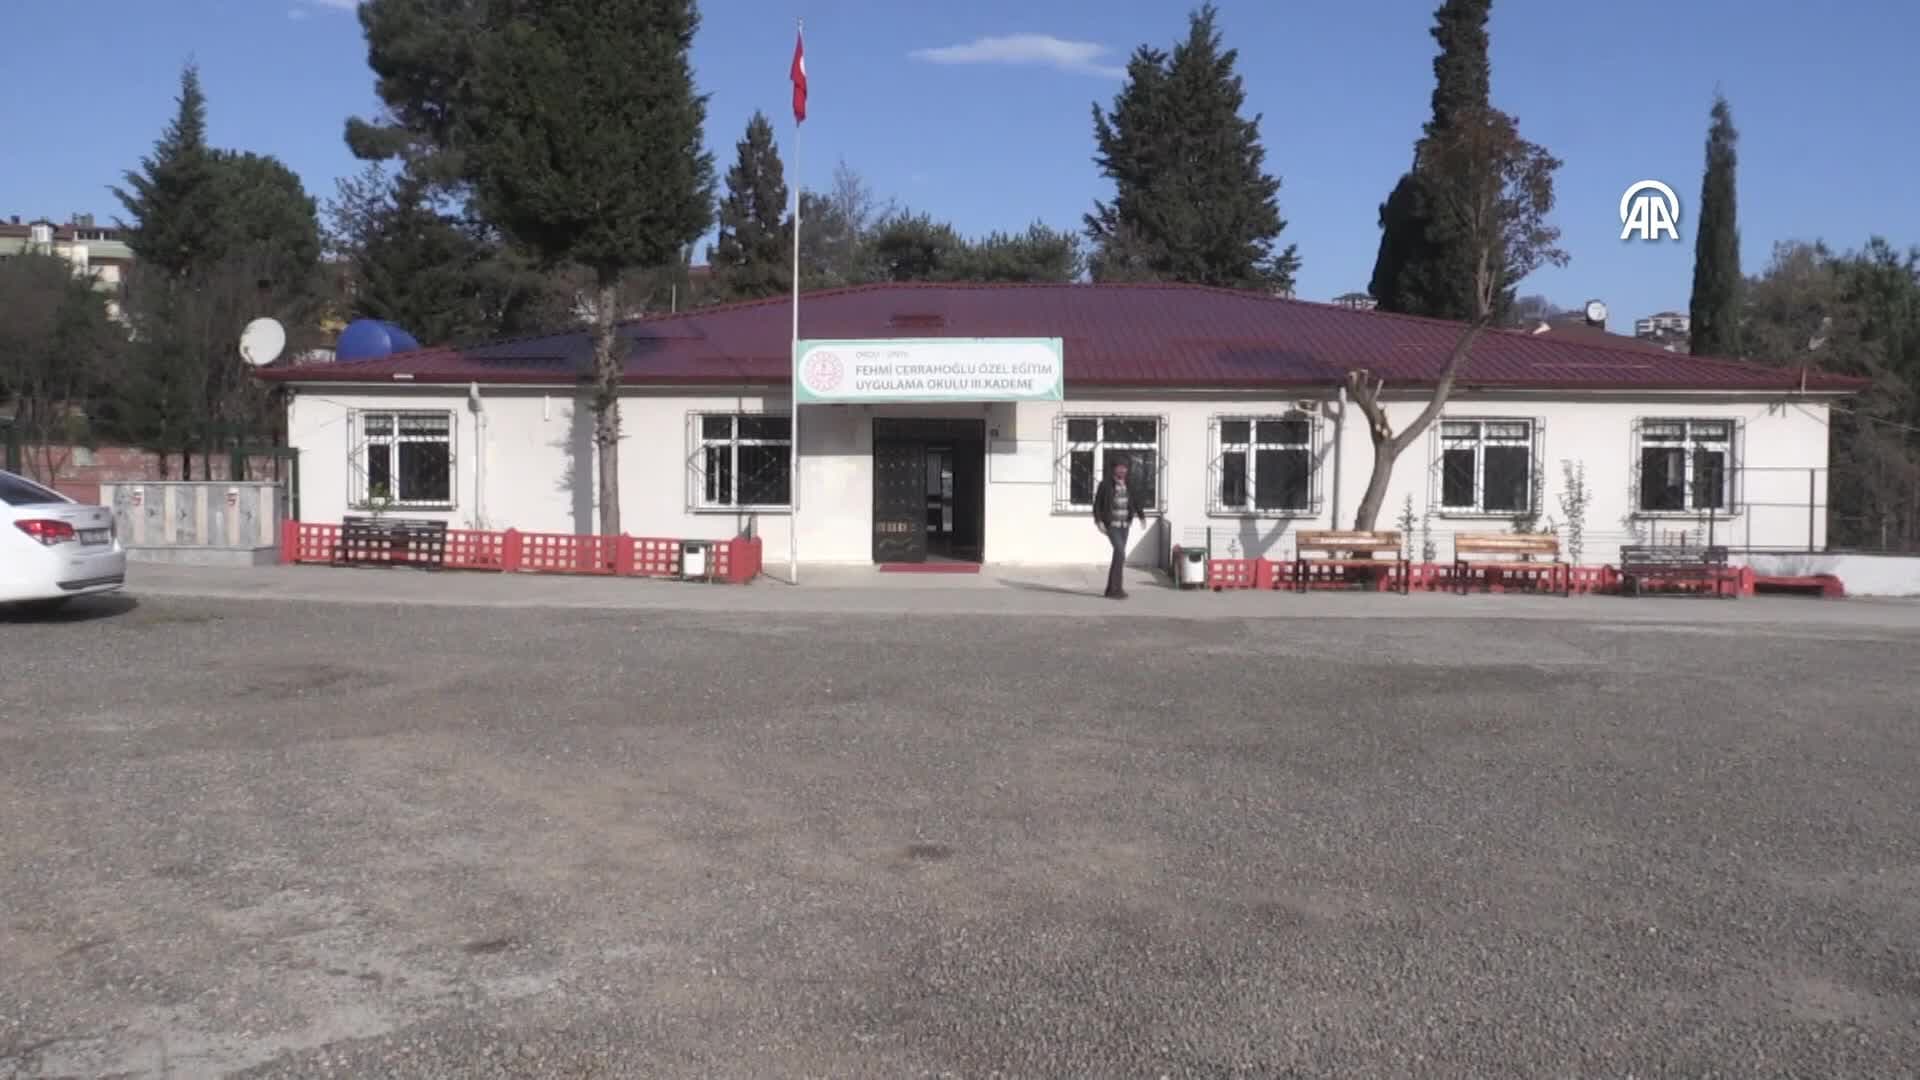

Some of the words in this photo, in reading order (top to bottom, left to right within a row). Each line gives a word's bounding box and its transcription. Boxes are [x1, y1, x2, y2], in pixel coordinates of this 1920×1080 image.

[856, 363, 893, 376] FEHMİ
[895, 362, 975, 376] CERRAHOĞLU
[978, 361, 1010, 374] ÖZEL
[1012, 361, 1053, 374] EĞİTİM
[856, 379, 924, 391] UYGULAMA
[927, 378, 968, 390] OKULU
